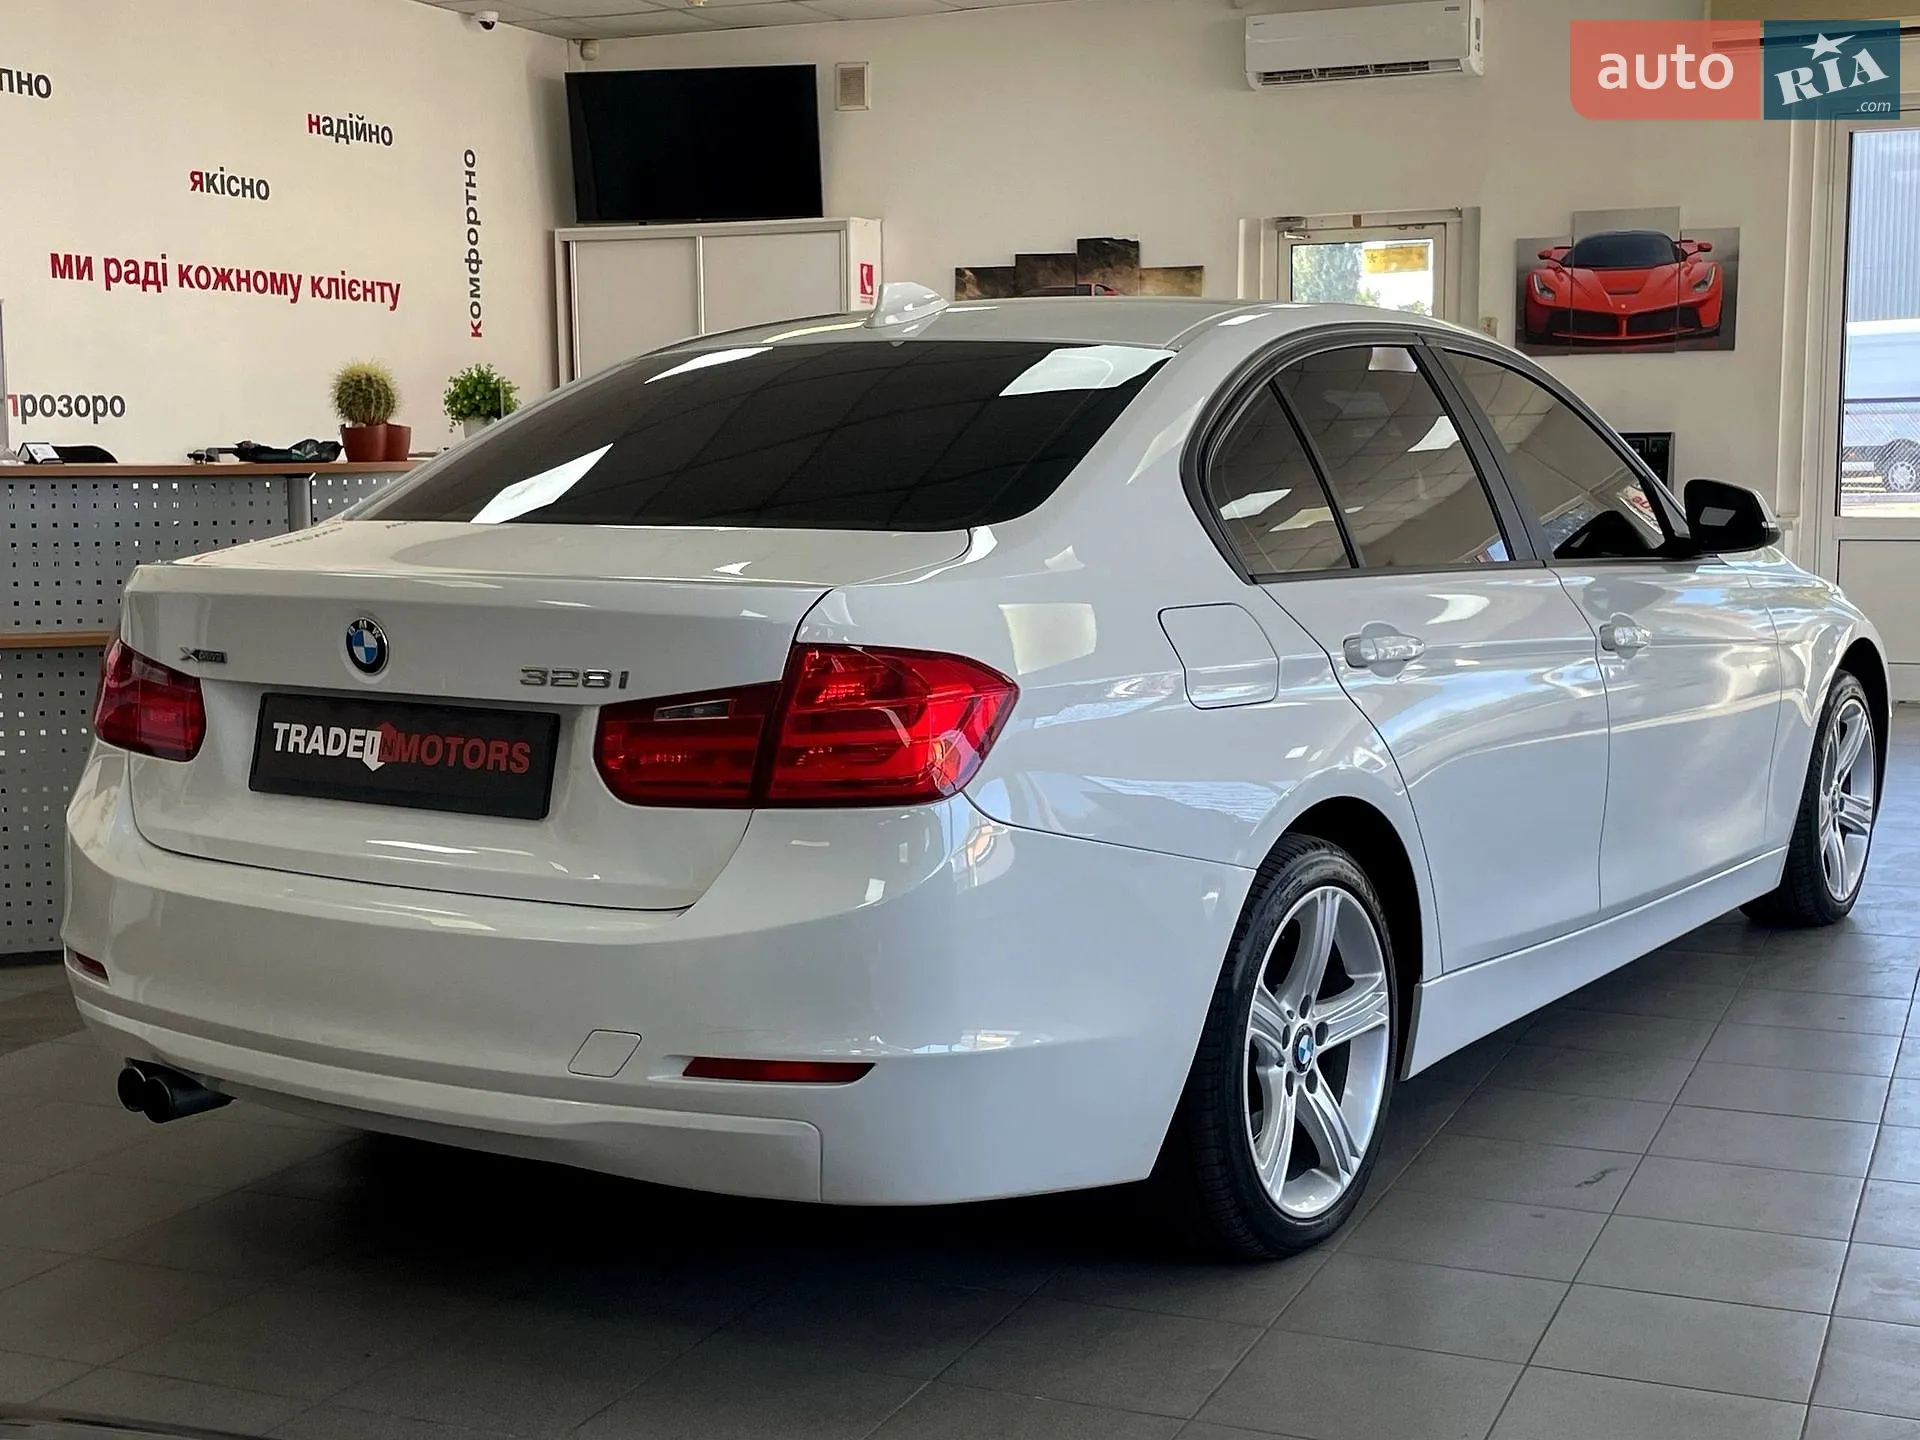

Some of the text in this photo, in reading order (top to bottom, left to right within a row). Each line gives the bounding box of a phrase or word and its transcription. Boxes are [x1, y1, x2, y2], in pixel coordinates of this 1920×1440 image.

[307, 113, 393, 146] надійно
[190, 166, 270, 201] якісно
[464, 149, 483, 338] комфортно
[50, 252, 400, 311] ми раді кожному клієнту
